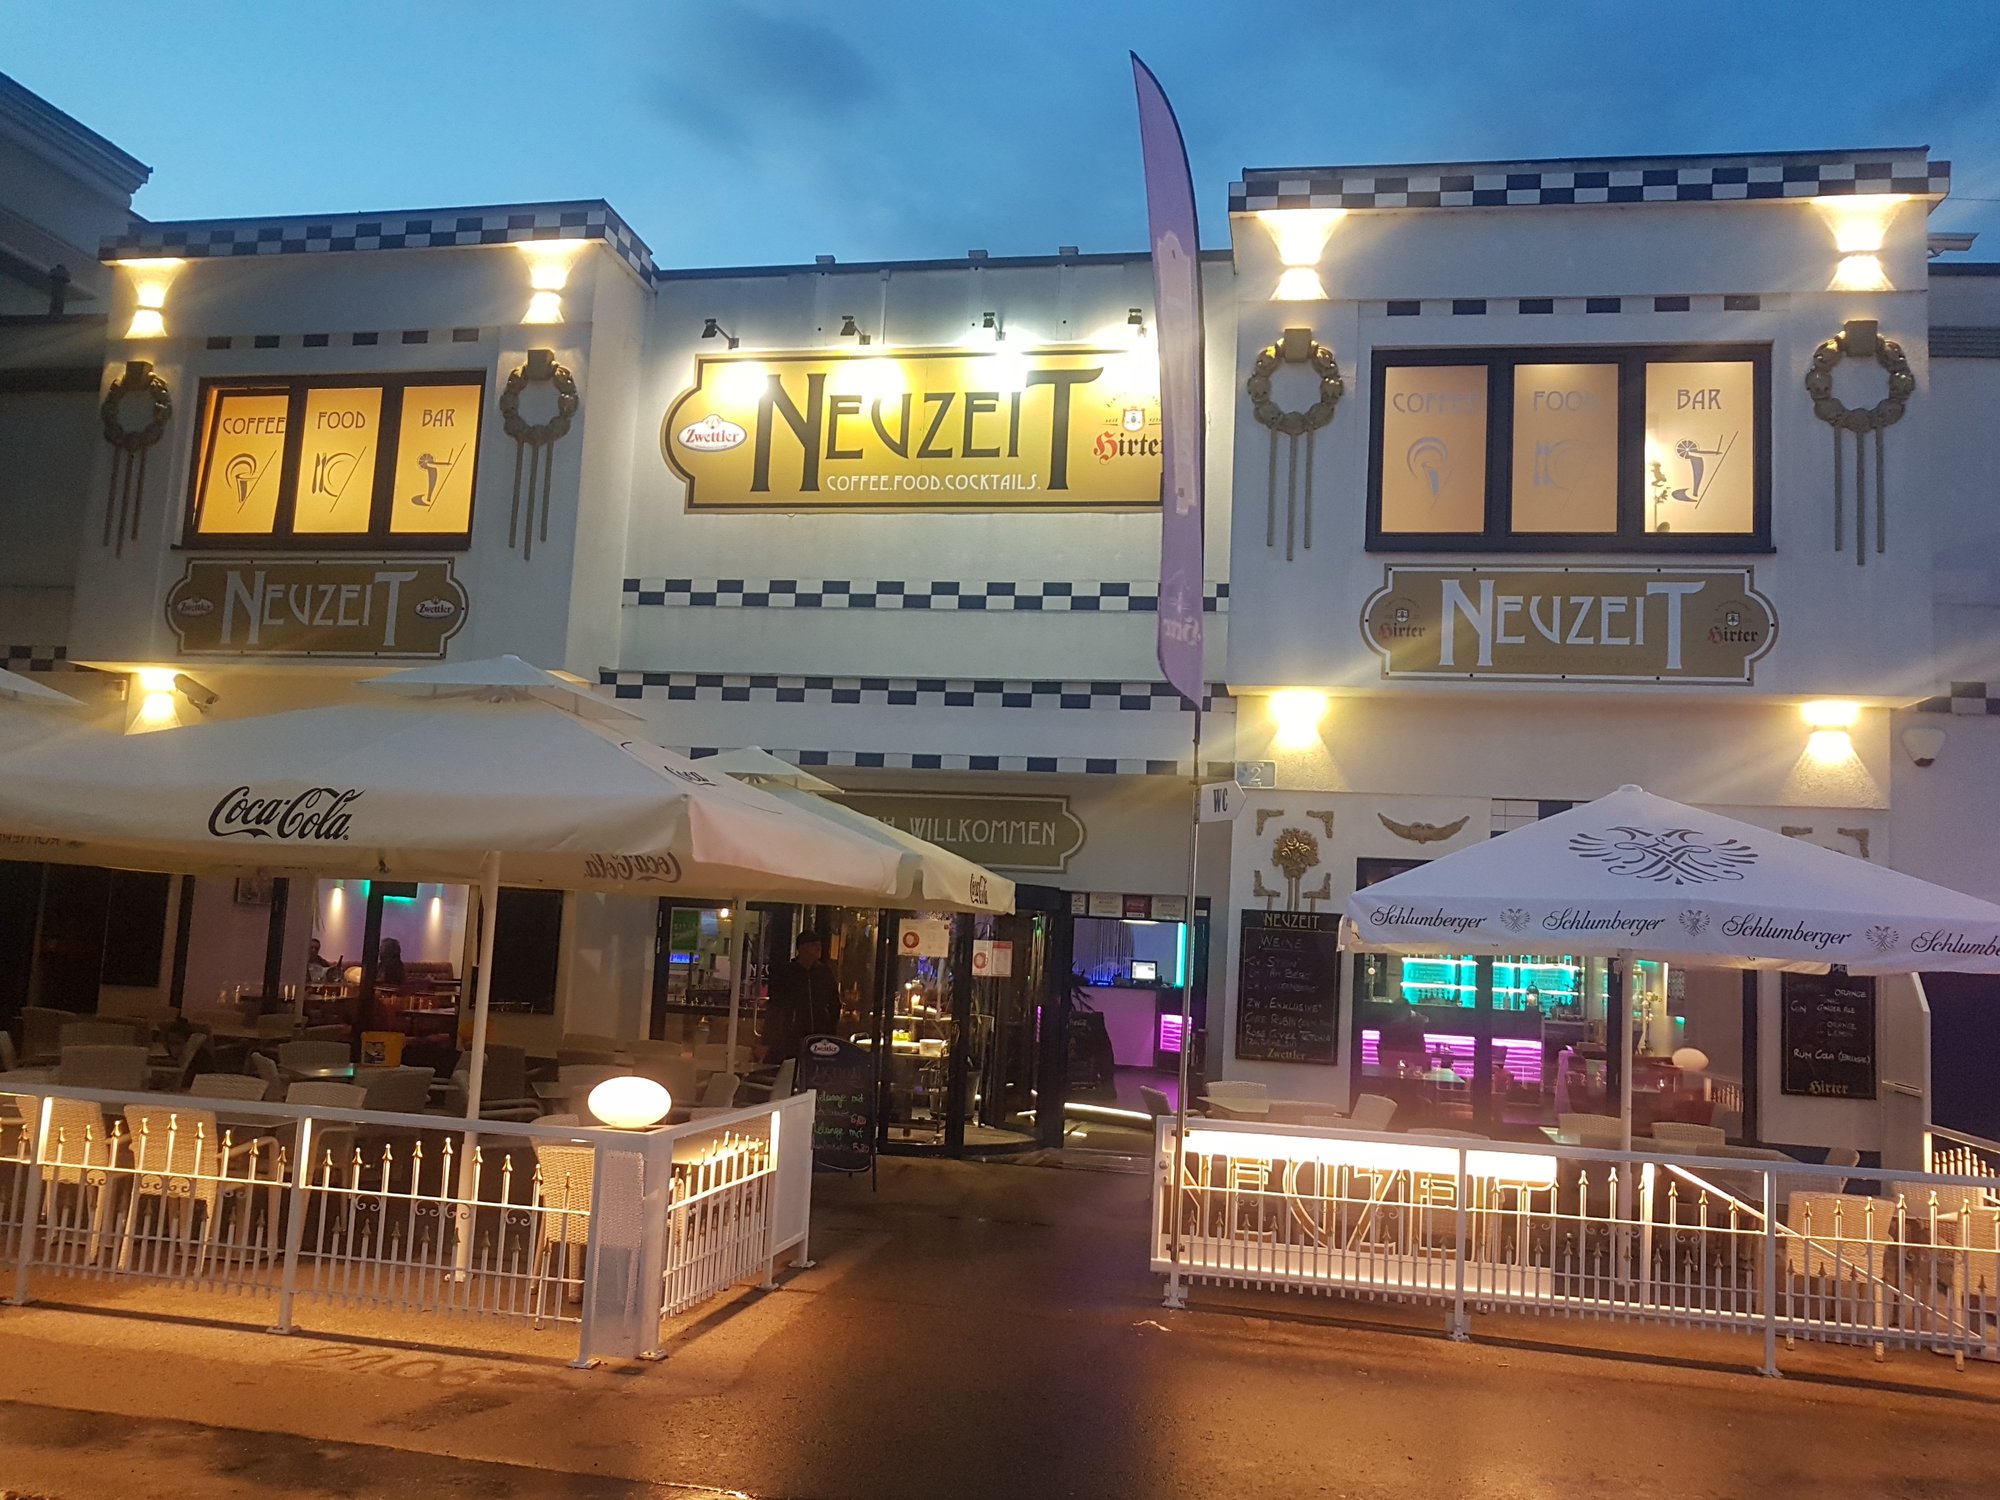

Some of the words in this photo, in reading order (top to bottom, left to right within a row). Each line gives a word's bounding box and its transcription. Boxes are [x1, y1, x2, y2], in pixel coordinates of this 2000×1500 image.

[1676, 388, 1722, 410] BAR
[222, 416, 286, 435] COFFEE
[317, 411, 366, 429] FOOD
[422, 408, 455, 427] BAR
[685, 426, 740, 444] Zwettler
[750, 367, 1104, 492] NEUZEIT
[220, 570, 418, 646] NEUZEIT
[418, 603, 452, 615] Zwettler
[1378, 622, 1426, 640] Hirter
[1439, 579, 1706, 669] NEUZEIT
[1707, 625, 1759, 644] Hirter
[1213, 788, 1228, 813] WC
[208, 786, 366, 840] Coca-Cola
[910, 817, 1056, 845] WILLKOMMEN
[1264, 913, 1320, 929] NEUZEIT
[1369, 904, 1487, 933] Schlumberger
[1542, 907, 1665, 937] Schlumberger
[1721, 913, 1851, 950] Schlumberger
[1267, 1049, 1306, 1060] Zwettler
[1793, 1048, 1812, 1059] RUM
[1809, 1080, 1849, 1094] Hirter
